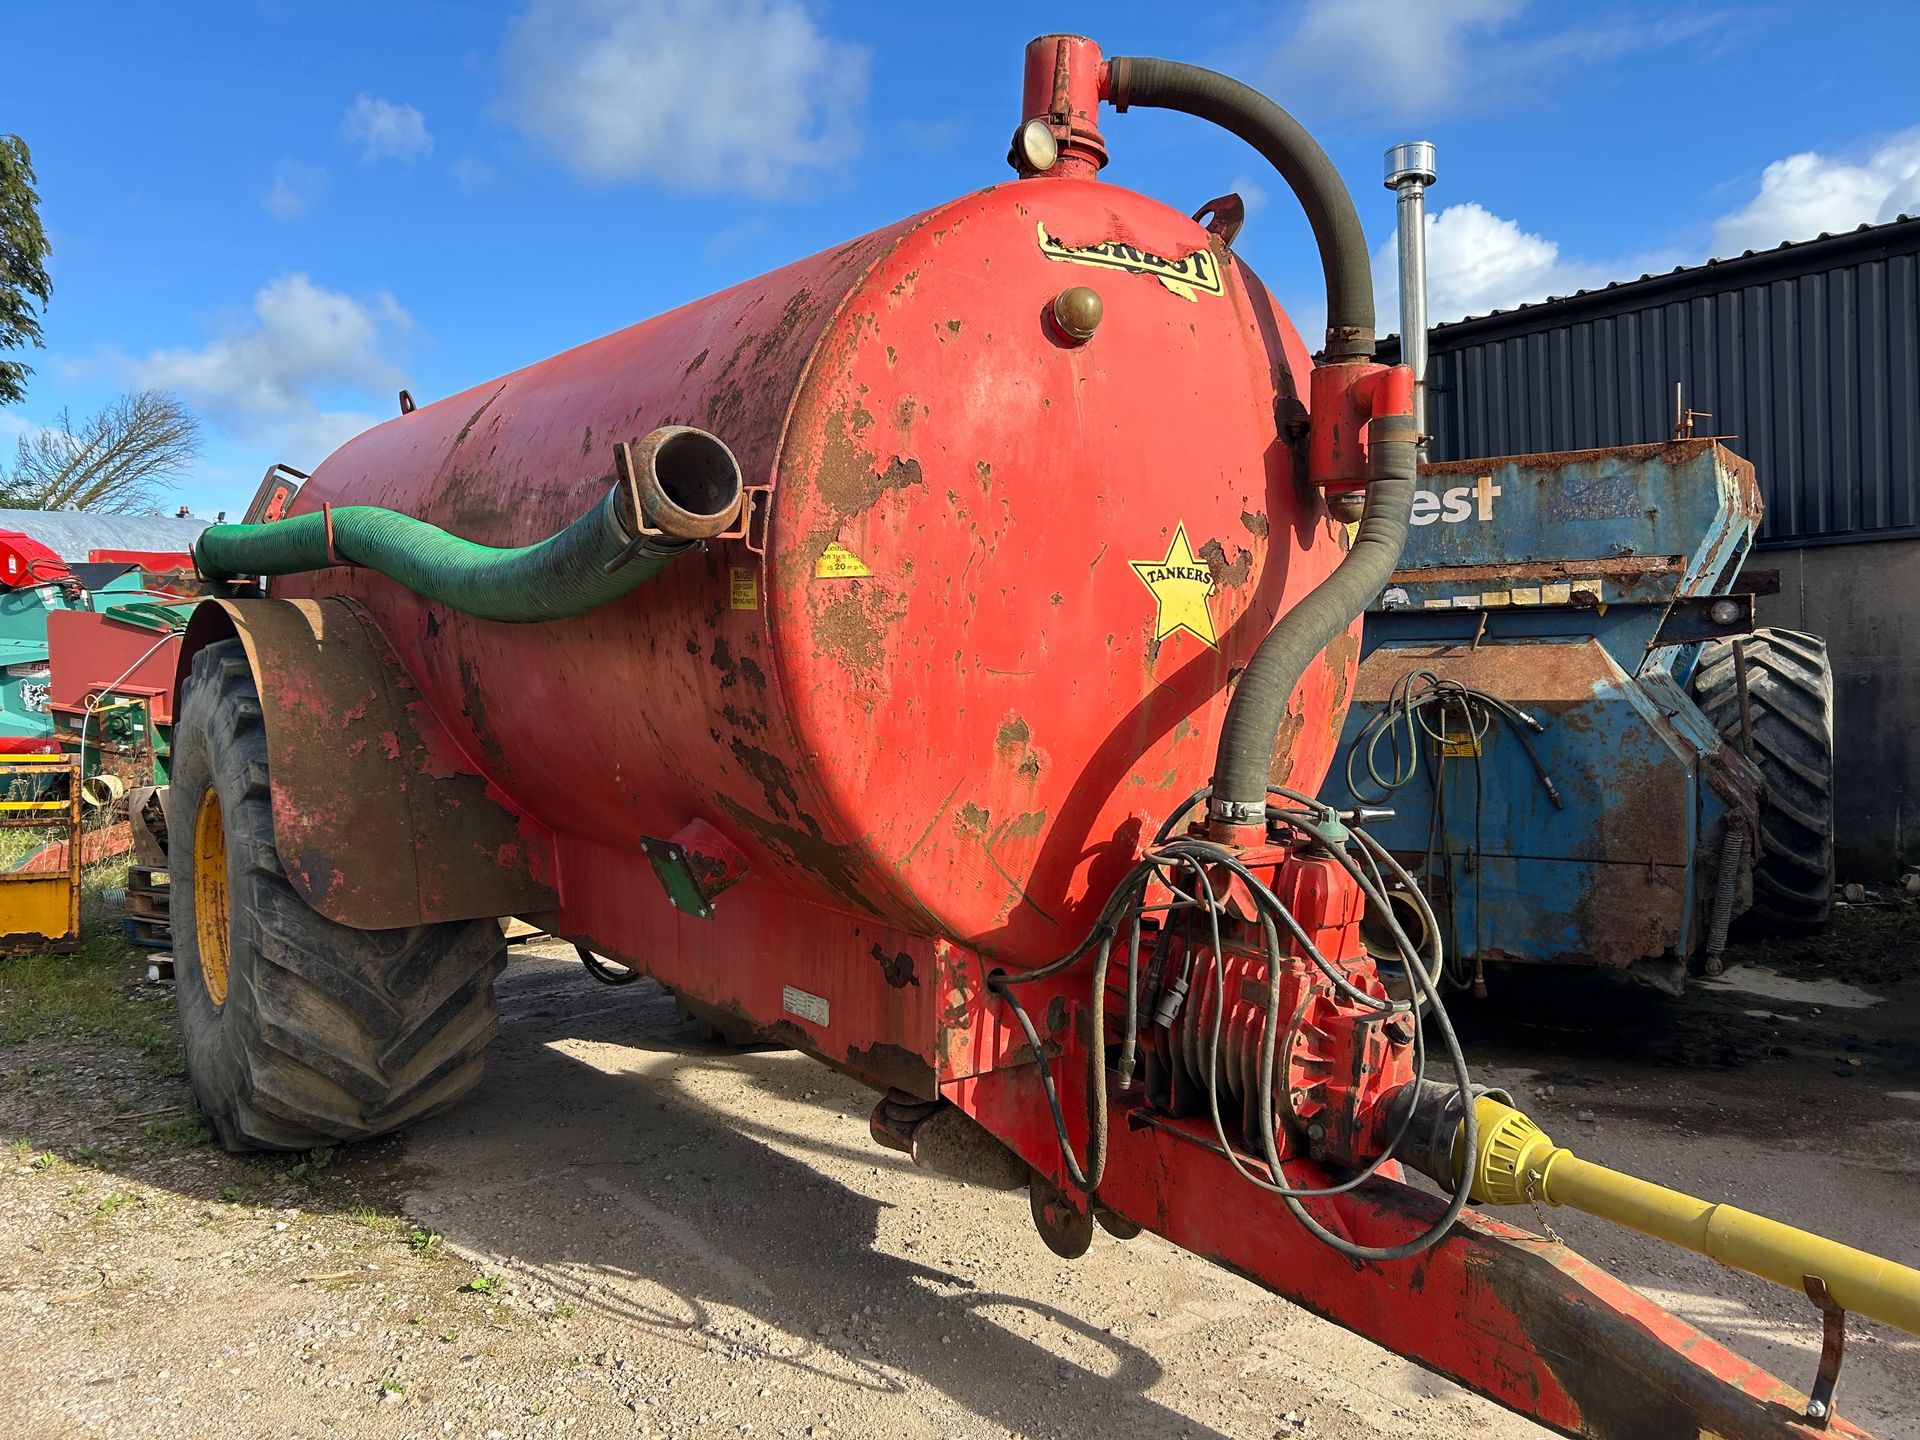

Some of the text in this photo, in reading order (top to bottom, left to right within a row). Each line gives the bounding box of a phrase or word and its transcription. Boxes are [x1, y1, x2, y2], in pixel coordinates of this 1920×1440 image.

[1409, 476, 1502, 526] est
[834, 562, 846, 570] 20
[1147, 566, 1213, 584] TANKERS
